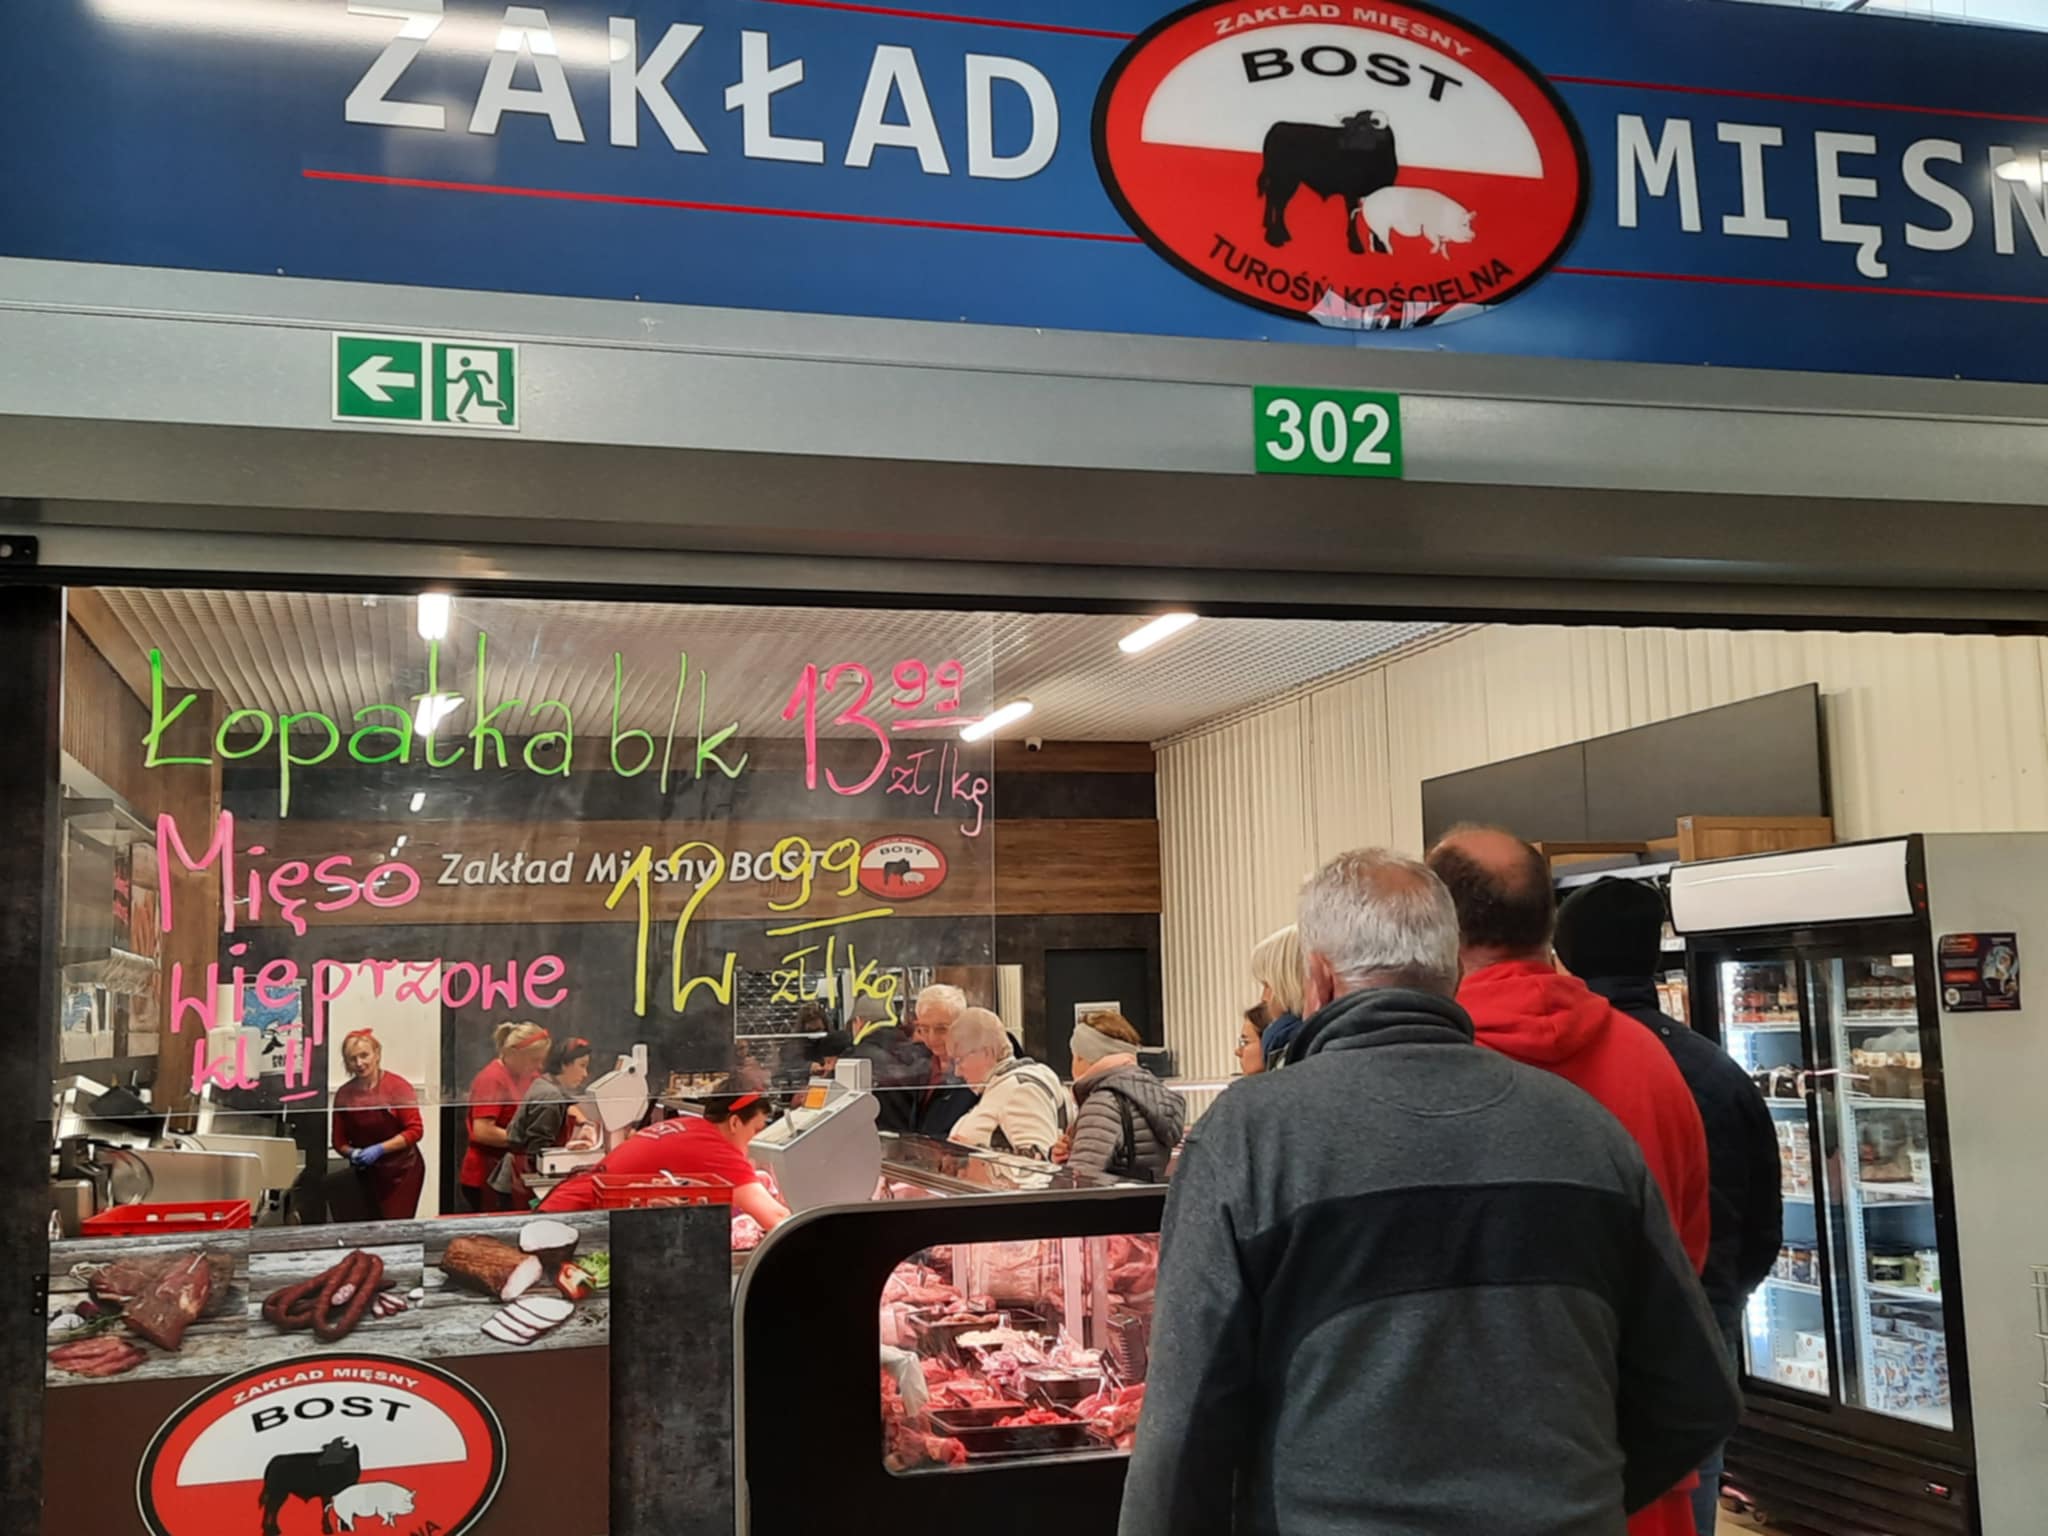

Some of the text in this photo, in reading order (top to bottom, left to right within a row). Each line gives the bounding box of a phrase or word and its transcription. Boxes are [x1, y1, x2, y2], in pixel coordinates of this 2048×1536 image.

[1214, 4, 1472, 57] ZAKŁAD MIĘSNY
[345, 0, 1060, 181] ZAKŁAD
[1241, 45, 1463, 103] BOST
[1343, 257, 1514, 317] KOŚCIELNA
[1265, 398, 1392, 464] 302
[143, 632, 573, 818] Łopatka
[611, 652, 748, 794] b/k
[886, 742, 989, 837] zł/kg
[437, 851, 575, 885] Zakład
[880, 845, 924, 856] BOST
[770, 936, 898, 1046] zł/kg
[233, 1367, 419, 1405] ZAKŁAD MIĘSNY
[251, 1396, 412, 1434] BOST
